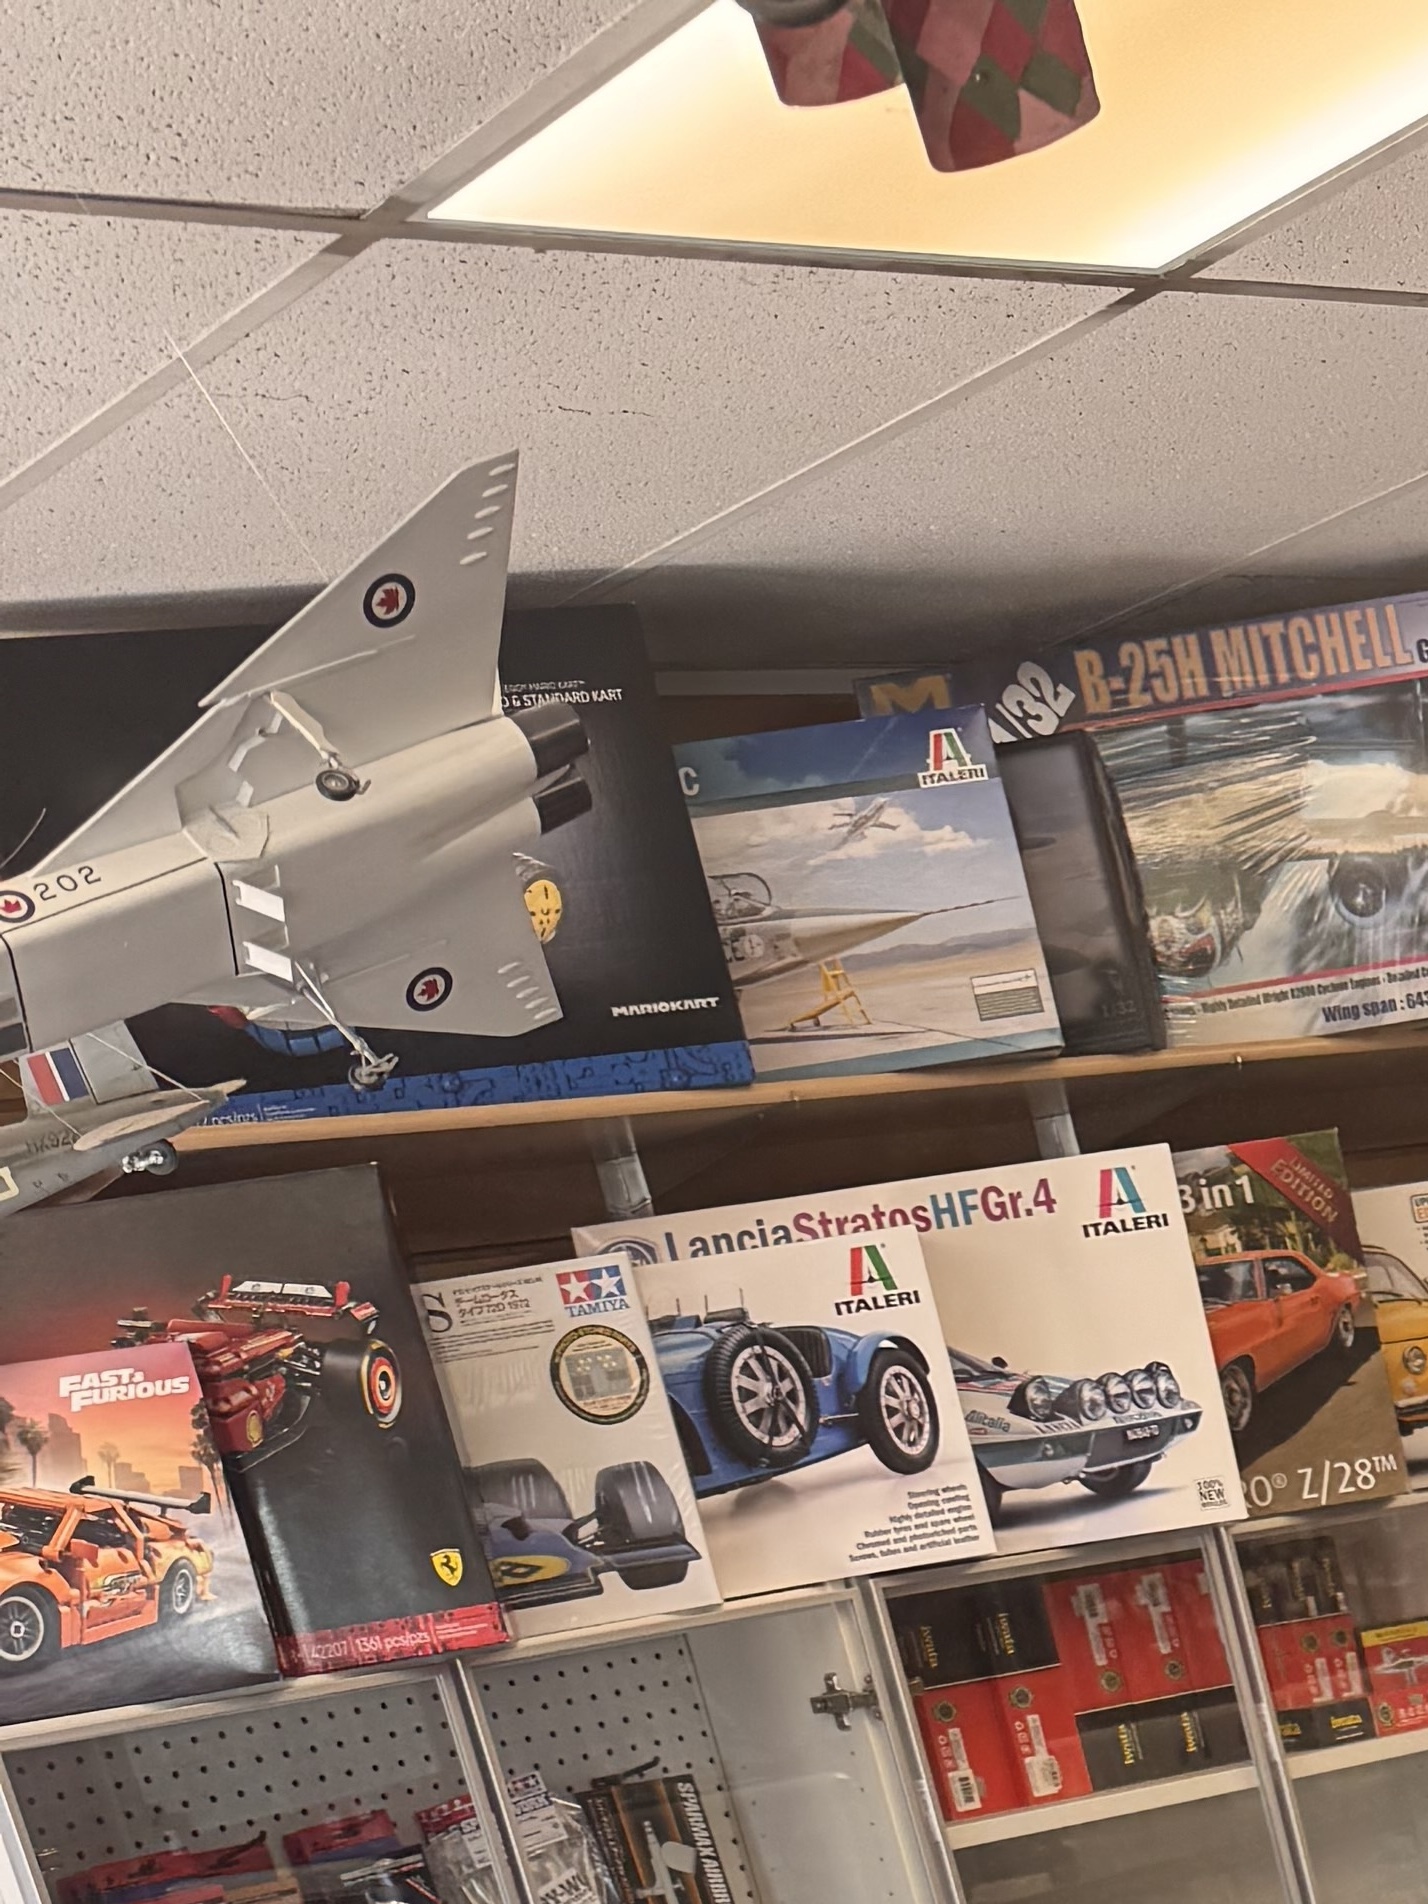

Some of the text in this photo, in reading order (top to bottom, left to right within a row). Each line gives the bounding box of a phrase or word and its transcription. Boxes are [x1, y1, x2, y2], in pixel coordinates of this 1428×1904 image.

[1076, 622, 1198, 713] B-25H
[1209, 604, 1413, 700] MITCHELL
[590, 689, 623, 703] KART
[921, 767, 985, 786] ITALERI
[33, 864, 101, 901] 202
[1322, 1004, 1359, 1026] Wing
[1201, 1174, 1255, 1211] in 1
[1269, 1158, 1339, 1224] EDITION
[1290, 1155, 1335, 1200] LIMITED
[1081, 1213, 1171, 1240] ITALERI
[564, 1298, 631, 1318] TAMIYA
[834, 1289, 921, 1316] ITALERI
[60, 1368, 133, 1399] FAST
[71, 1375, 190, 1413] FURIOUS
[309, 1641, 350, 1659] 42207
[997, 1610, 1017, 1657] iwata
[676, 1779, 714, 1858] SPARMAX
